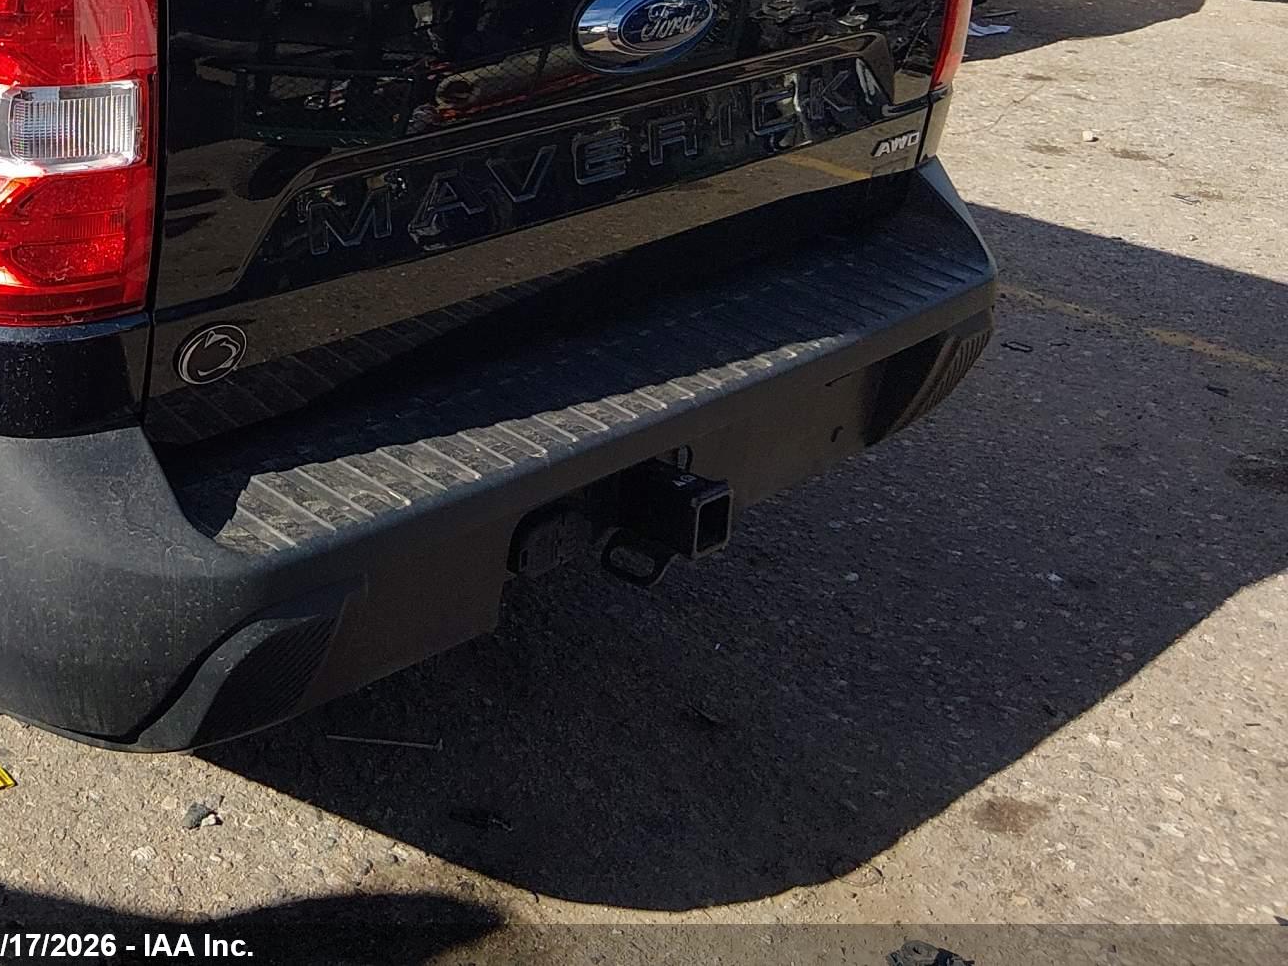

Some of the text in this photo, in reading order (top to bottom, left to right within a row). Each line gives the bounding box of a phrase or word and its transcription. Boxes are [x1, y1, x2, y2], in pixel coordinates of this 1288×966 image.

[640, 0, 699, 42] Ford
[309, 68, 854, 255] MAVERICK
[873, 131, 921, 158] AWD
